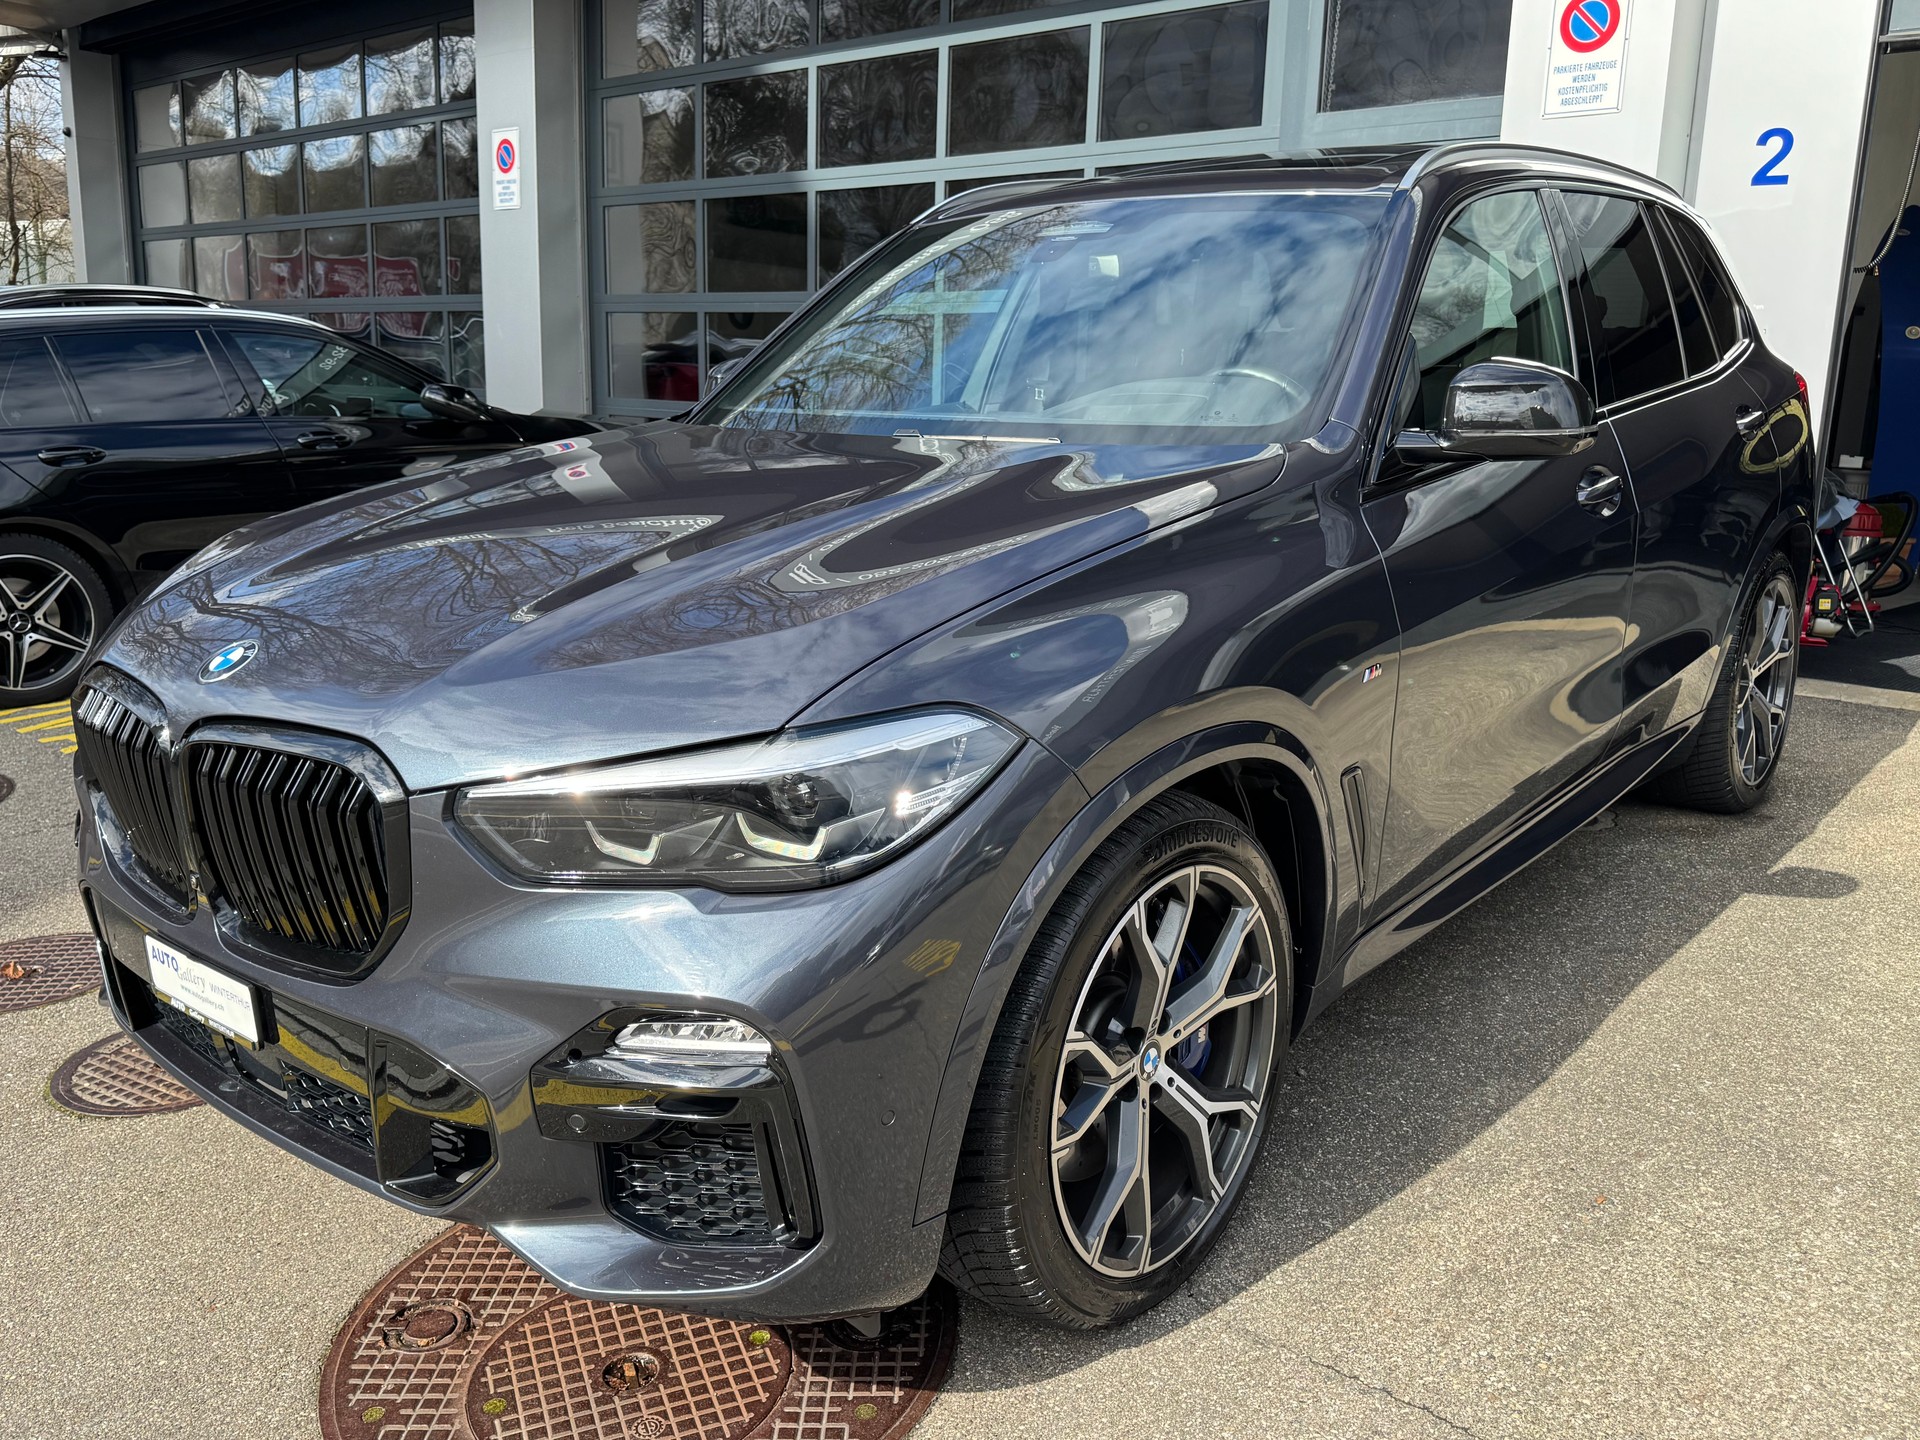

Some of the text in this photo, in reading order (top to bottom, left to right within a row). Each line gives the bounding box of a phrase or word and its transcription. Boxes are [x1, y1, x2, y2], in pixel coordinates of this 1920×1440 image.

[1553, 60, 1618, 74] PARKIERTE FAHRZEUGE
[1572, 73, 1597, 83] WERDEN
[1557, 82, 1608, 96] KOSTENPFLICHTIG
[1560, 94, 1603, 106] ABGESCHLEPPT
[1750, 127, 1795, 187] 2
[151, 945, 251, 1012] AUTO Gallery WINTERTHUR
